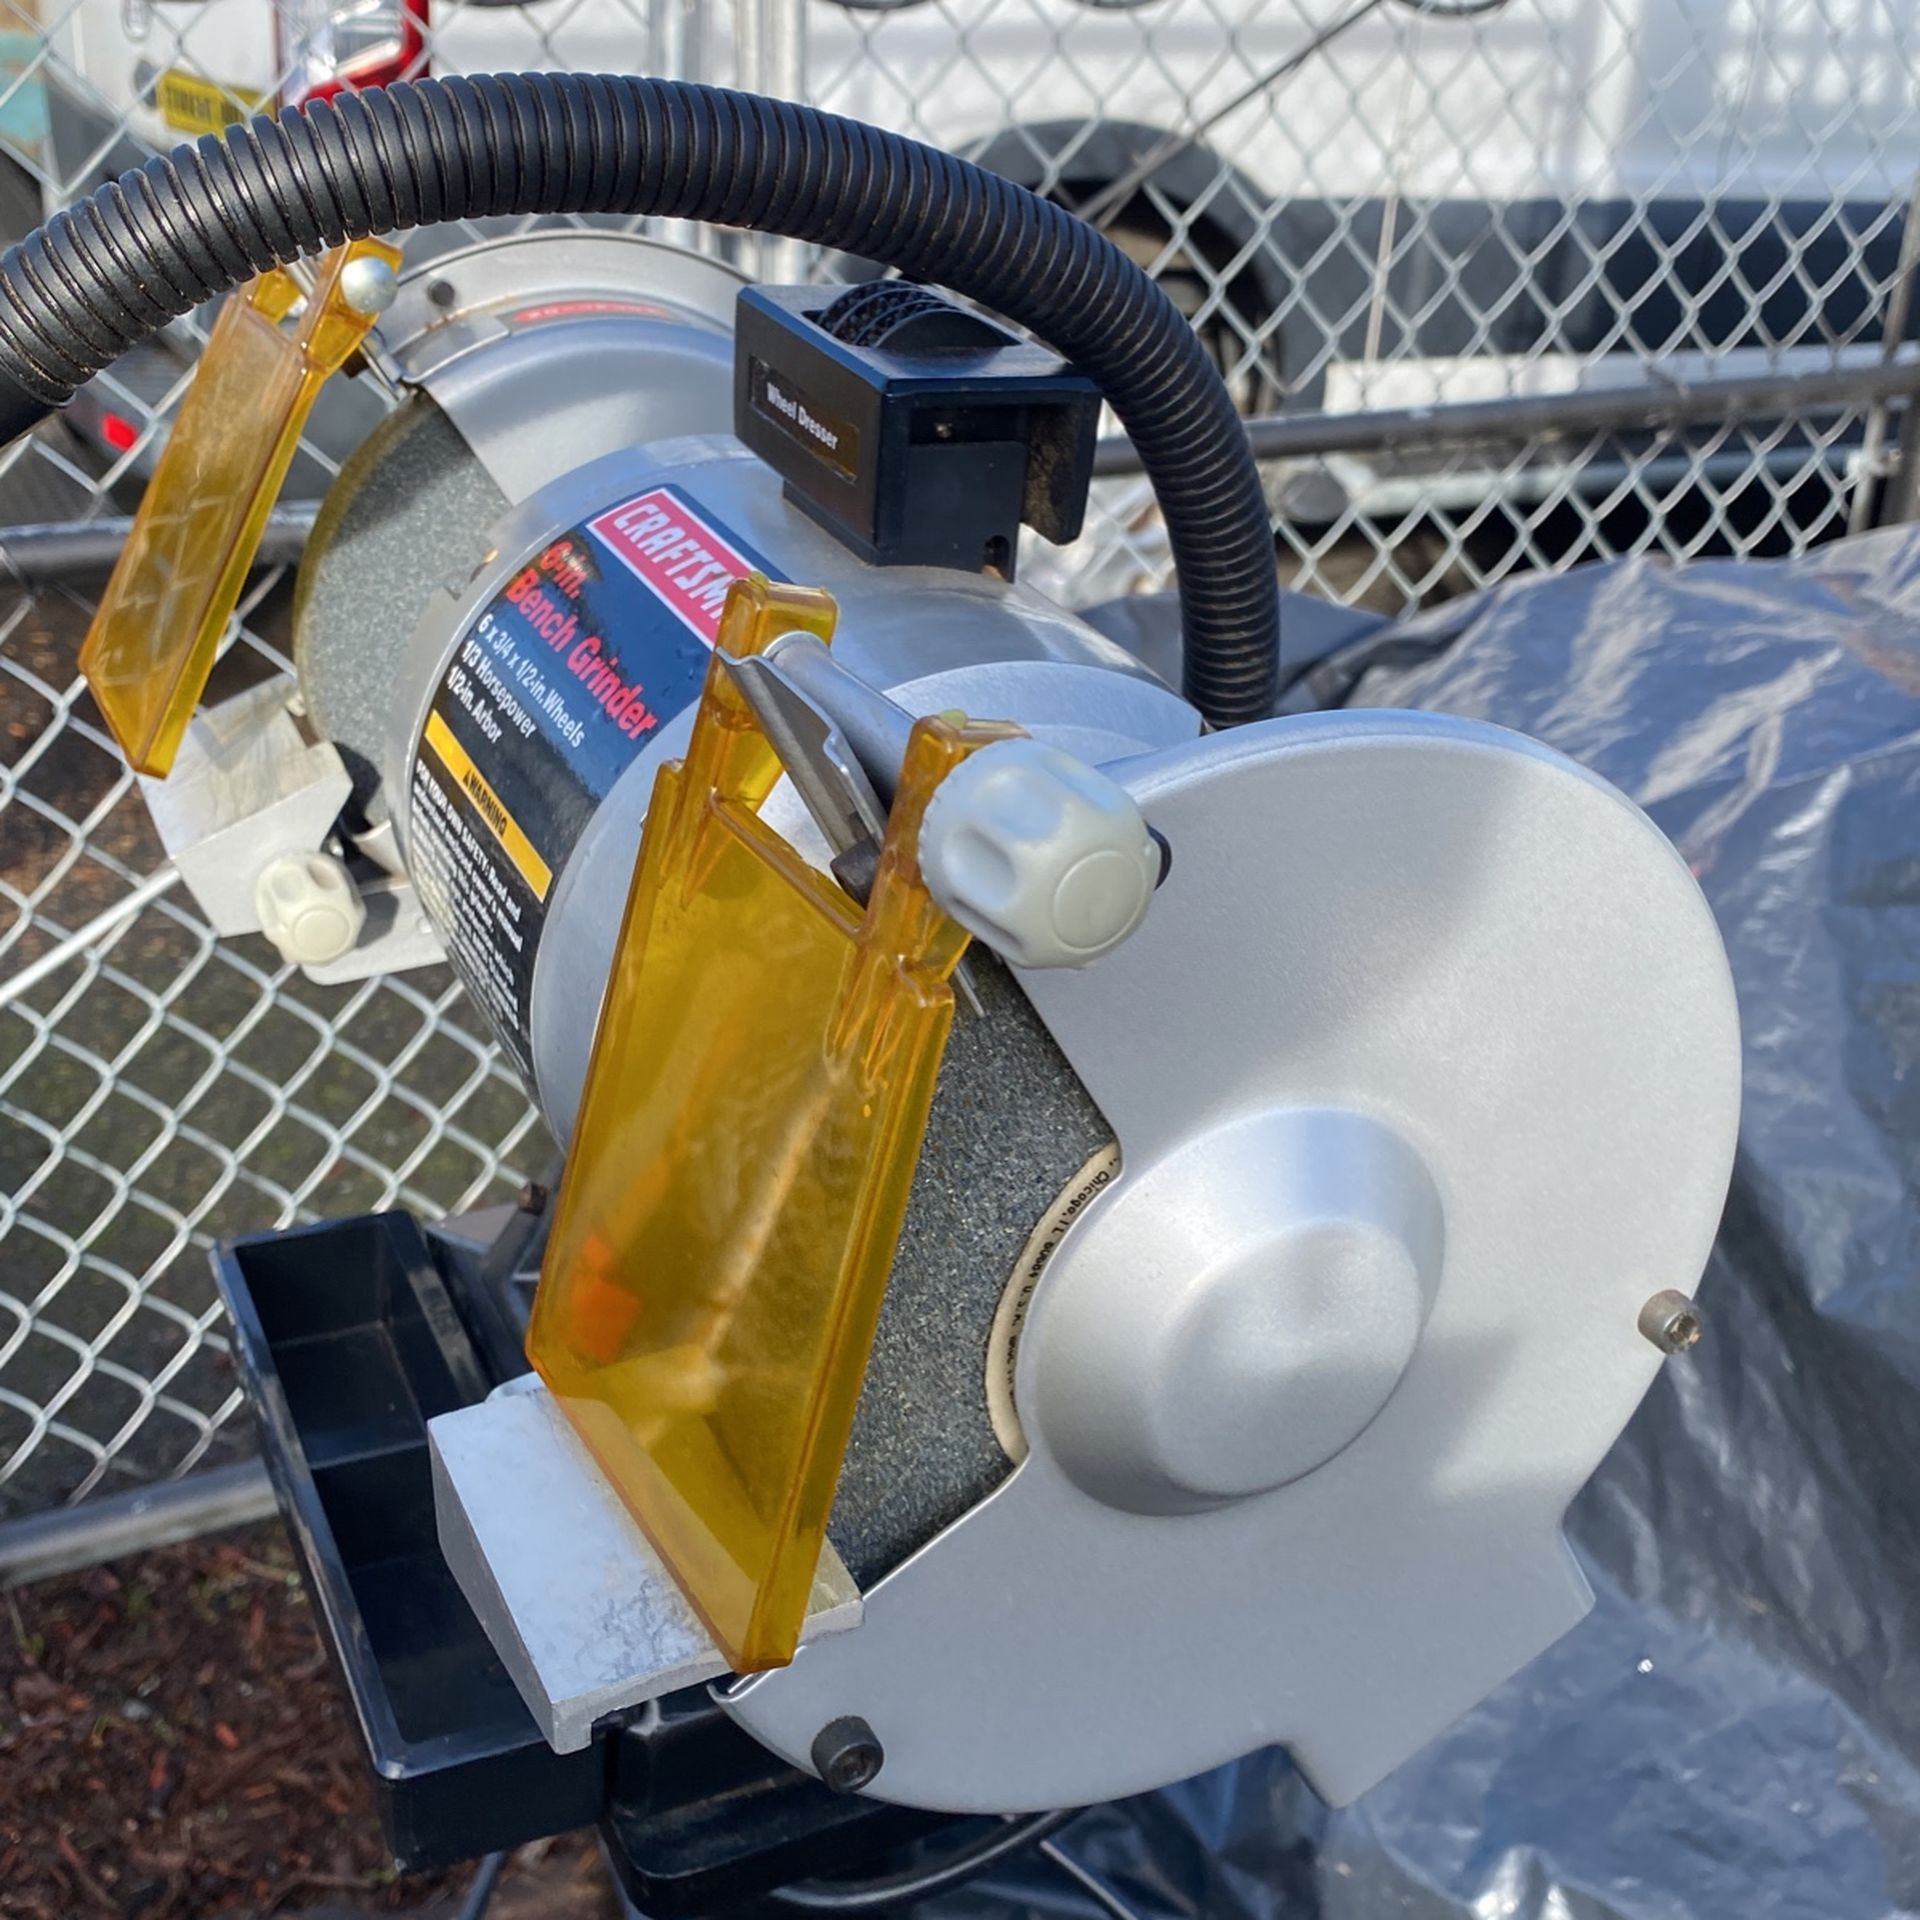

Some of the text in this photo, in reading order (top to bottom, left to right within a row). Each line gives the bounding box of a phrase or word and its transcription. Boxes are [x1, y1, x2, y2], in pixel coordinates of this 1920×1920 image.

[766, 381, 839, 451] Wheel Dresser
[540, 541, 588, 600] 6-in.
[612, 502, 735, 620] CRAFTSM
[478, 613, 494, 634] 6
[484, 625, 500, 644] x
[492, 630, 517, 661] 3/4
[505, 567, 658, 741] Bench Grinder
[461, 638, 538, 740] 1/3 Horsepower
[506, 653, 521, 670] x
[446, 665, 504, 745] 1/2-in. Arbor
[468, 770, 508, 838] WARNING
[429, 777, 449, 814] YOUR
[446, 803, 464, 837] OWN
[462, 826, 490, 877] SAFETY:
[488, 866, 509, 903] Read
[505, 895, 522, 923] and
